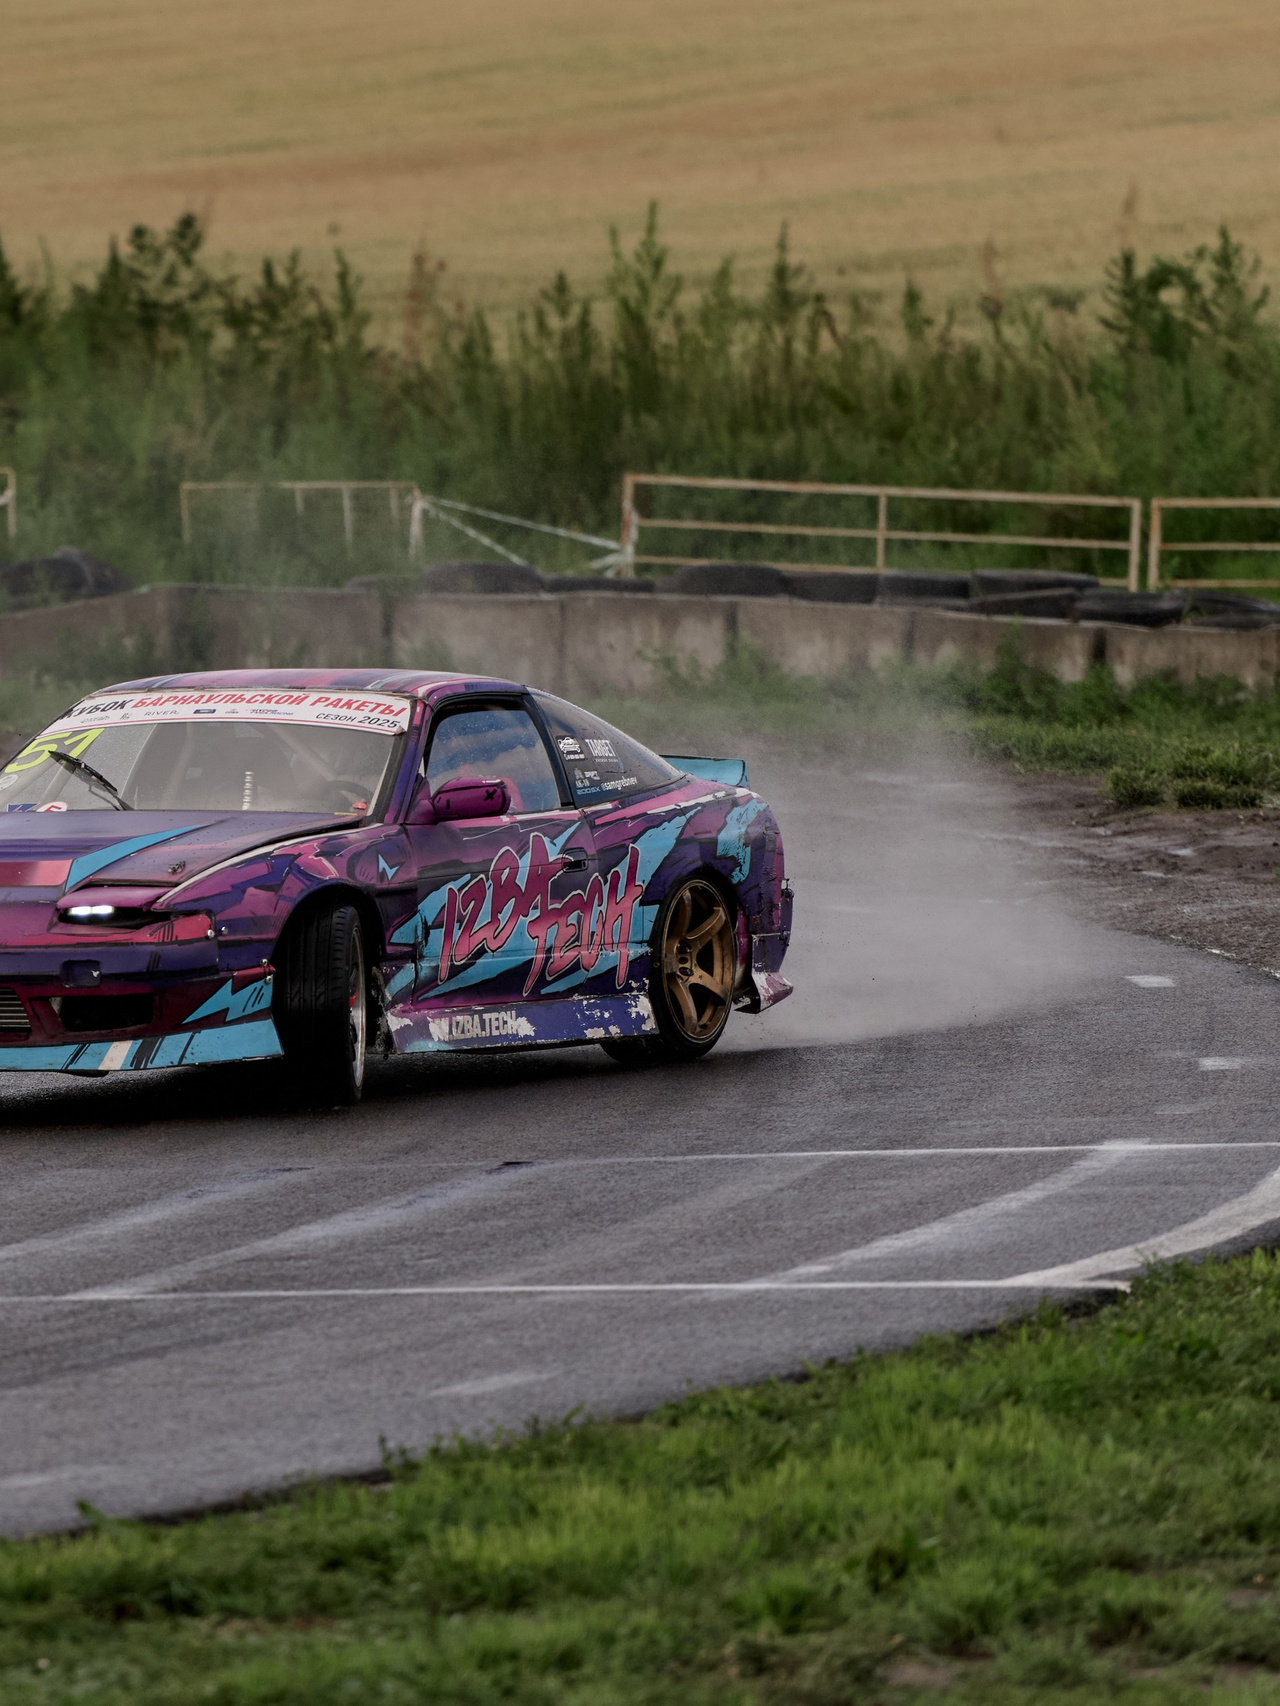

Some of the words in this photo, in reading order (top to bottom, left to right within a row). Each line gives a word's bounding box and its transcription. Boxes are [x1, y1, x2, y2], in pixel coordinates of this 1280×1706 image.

[131, 693, 310, 708] БАРНАУЛЬСКОЙ
[310, 696, 408, 717] РАКЕТЫ
[316, 713, 357, 722] СЕЗОН
[358, 716, 400, 728] 2025
[4, 728, 105, 773] 51
[585, 739, 616, 757] TARGET
